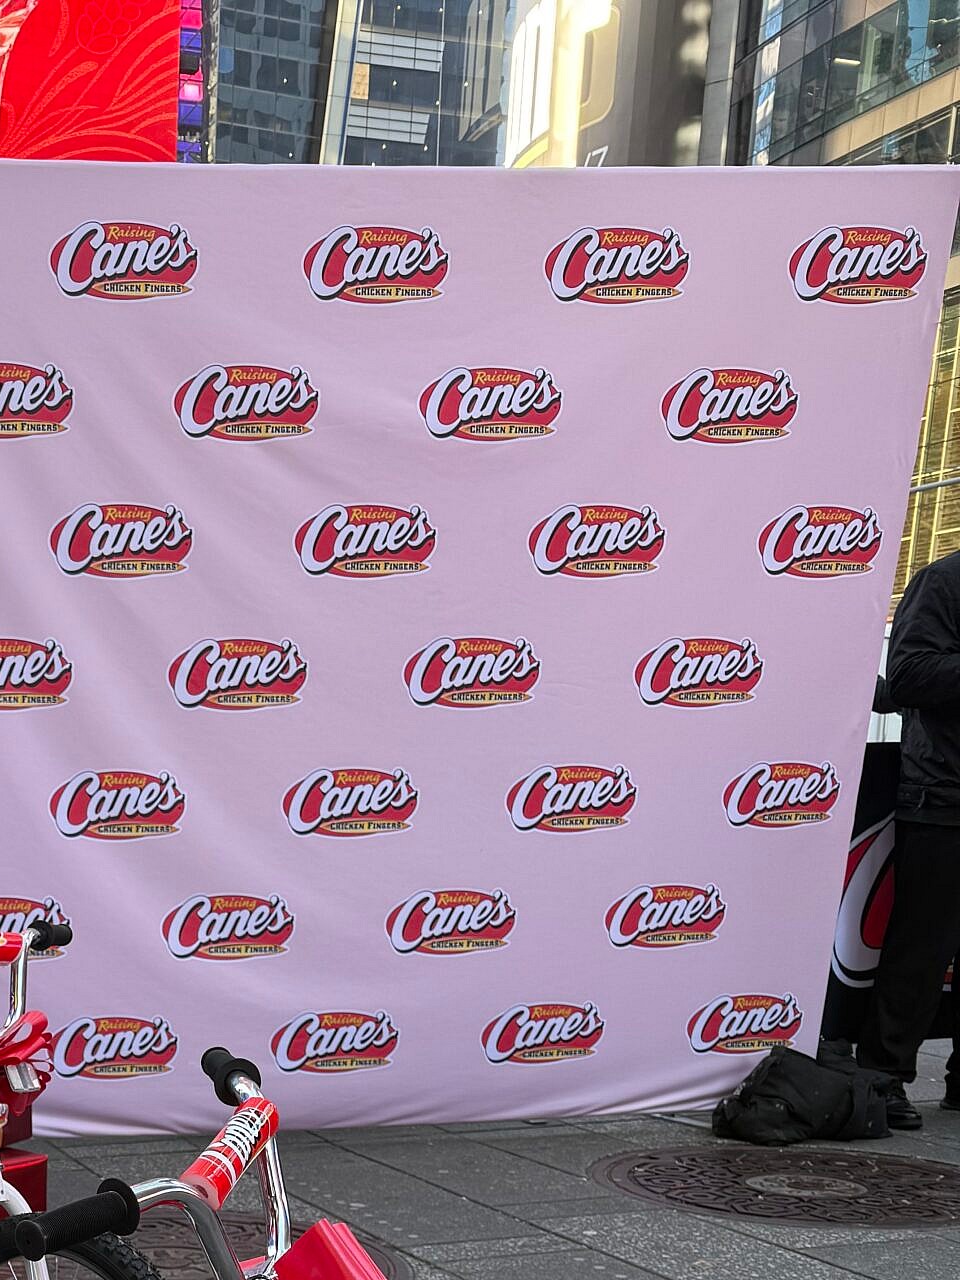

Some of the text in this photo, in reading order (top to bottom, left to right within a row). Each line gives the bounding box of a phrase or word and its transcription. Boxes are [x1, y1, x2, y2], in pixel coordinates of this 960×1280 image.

[108, 226, 156, 241] Raising
[360, 231, 408, 245] Raising
[602, 231, 650, 246] Raising
[846, 231, 892, 245] Raising
[57, 222, 197, 294] Cane's
[310, 226, 448, 298] Cane's
[551, 228, 688, 300] Cane's
[795, 226, 927, 299] Cane's
[104, 283, 183, 293] CHICKEN FINGERS
[355, 287, 433, 297] CHICKEN FINGERS
[596, 286, 673, 297] CHICKEN FINGERS
[836, 287, 911, 297] CHICKEN FINGERS
[230, 369, 278, 383] Raising
[475, 371, 522, 385] Raising
[716, 372, 762, 386] Raising
[181, 365, 317, 436] Cane's
[426, 367, 560, 436] Cane's
[667, 368, 797, 439] Cane's
[21, 422, 59, 432] FINGERS
[226, 424, 303, 434] CHICKEN FINGERS
[470, 425, 546, 434] CHICKEN FINGERS
[708, 427, 781, 437] CHICKEN FINGERS
[105, 508, 152, 521] Raising
[350, 508, 397, 522] Raising
[583, 509, 629, 522] Raising
[810, 510, 852, 523] Raising
[57, 504, 192, 573] Cane's
[301, 505, 435, 573] Cane's
[535, 505, 665, 573] Cane's
[764, 506, 884, 573] Cane's
[102, 562, 178, 571] CHICKEN FINGERS
[345, 561, 421, 571] CHICKEN FINGERS
[576, 561, 649, 571] CHICKEN FINGERS
[800, 562, 868, 572] CHICKEN FINGERS
[222, 642, 268, 655] Raising
[458, 641, 503, 654] Raising
[687, 642, 730, 654] Raising
[175, 639, 306, 706] Cane's
[410, 638, 539, 704] Cane's
[640, 638, 763, 703] Cane's
[22, 695, 58, 704] FINGERS
[218, 694, 292, 704] CHICKEN FINGERS
[451, 692, 524, 702] CHICKEN FINGERS
[678, 692, 747, 701] CHICKEN FINGERS
[336, 772, 381, 784] Raising
[559, 769, 602, 781] Raising
[772, 765, 811, 777] Raising
[102, 774, 147, 787] Raising
[512, 765, 636, 829] Cane's
[728, 762, 840, 824] Cane's
[56, 771, 184, 836] Cane's
[289, 768, 417, 833] Cane's
[438, 893, 481, 905] Raising
[654, 888, 695, 899] Raising
[214, 898, 257, 910] Raising
[392, 889, 515, 952] Cane's
[610, 884, 726, 945] Cane's
[168, 894, 293, 957] Cane's
[692, 994, 802, 1052] Cane's
[486, 1002, 604, 1062] Cane's
[54, 1016, 177, 1076] Cane's
[276, 1011, 398, 1070] Cane's
